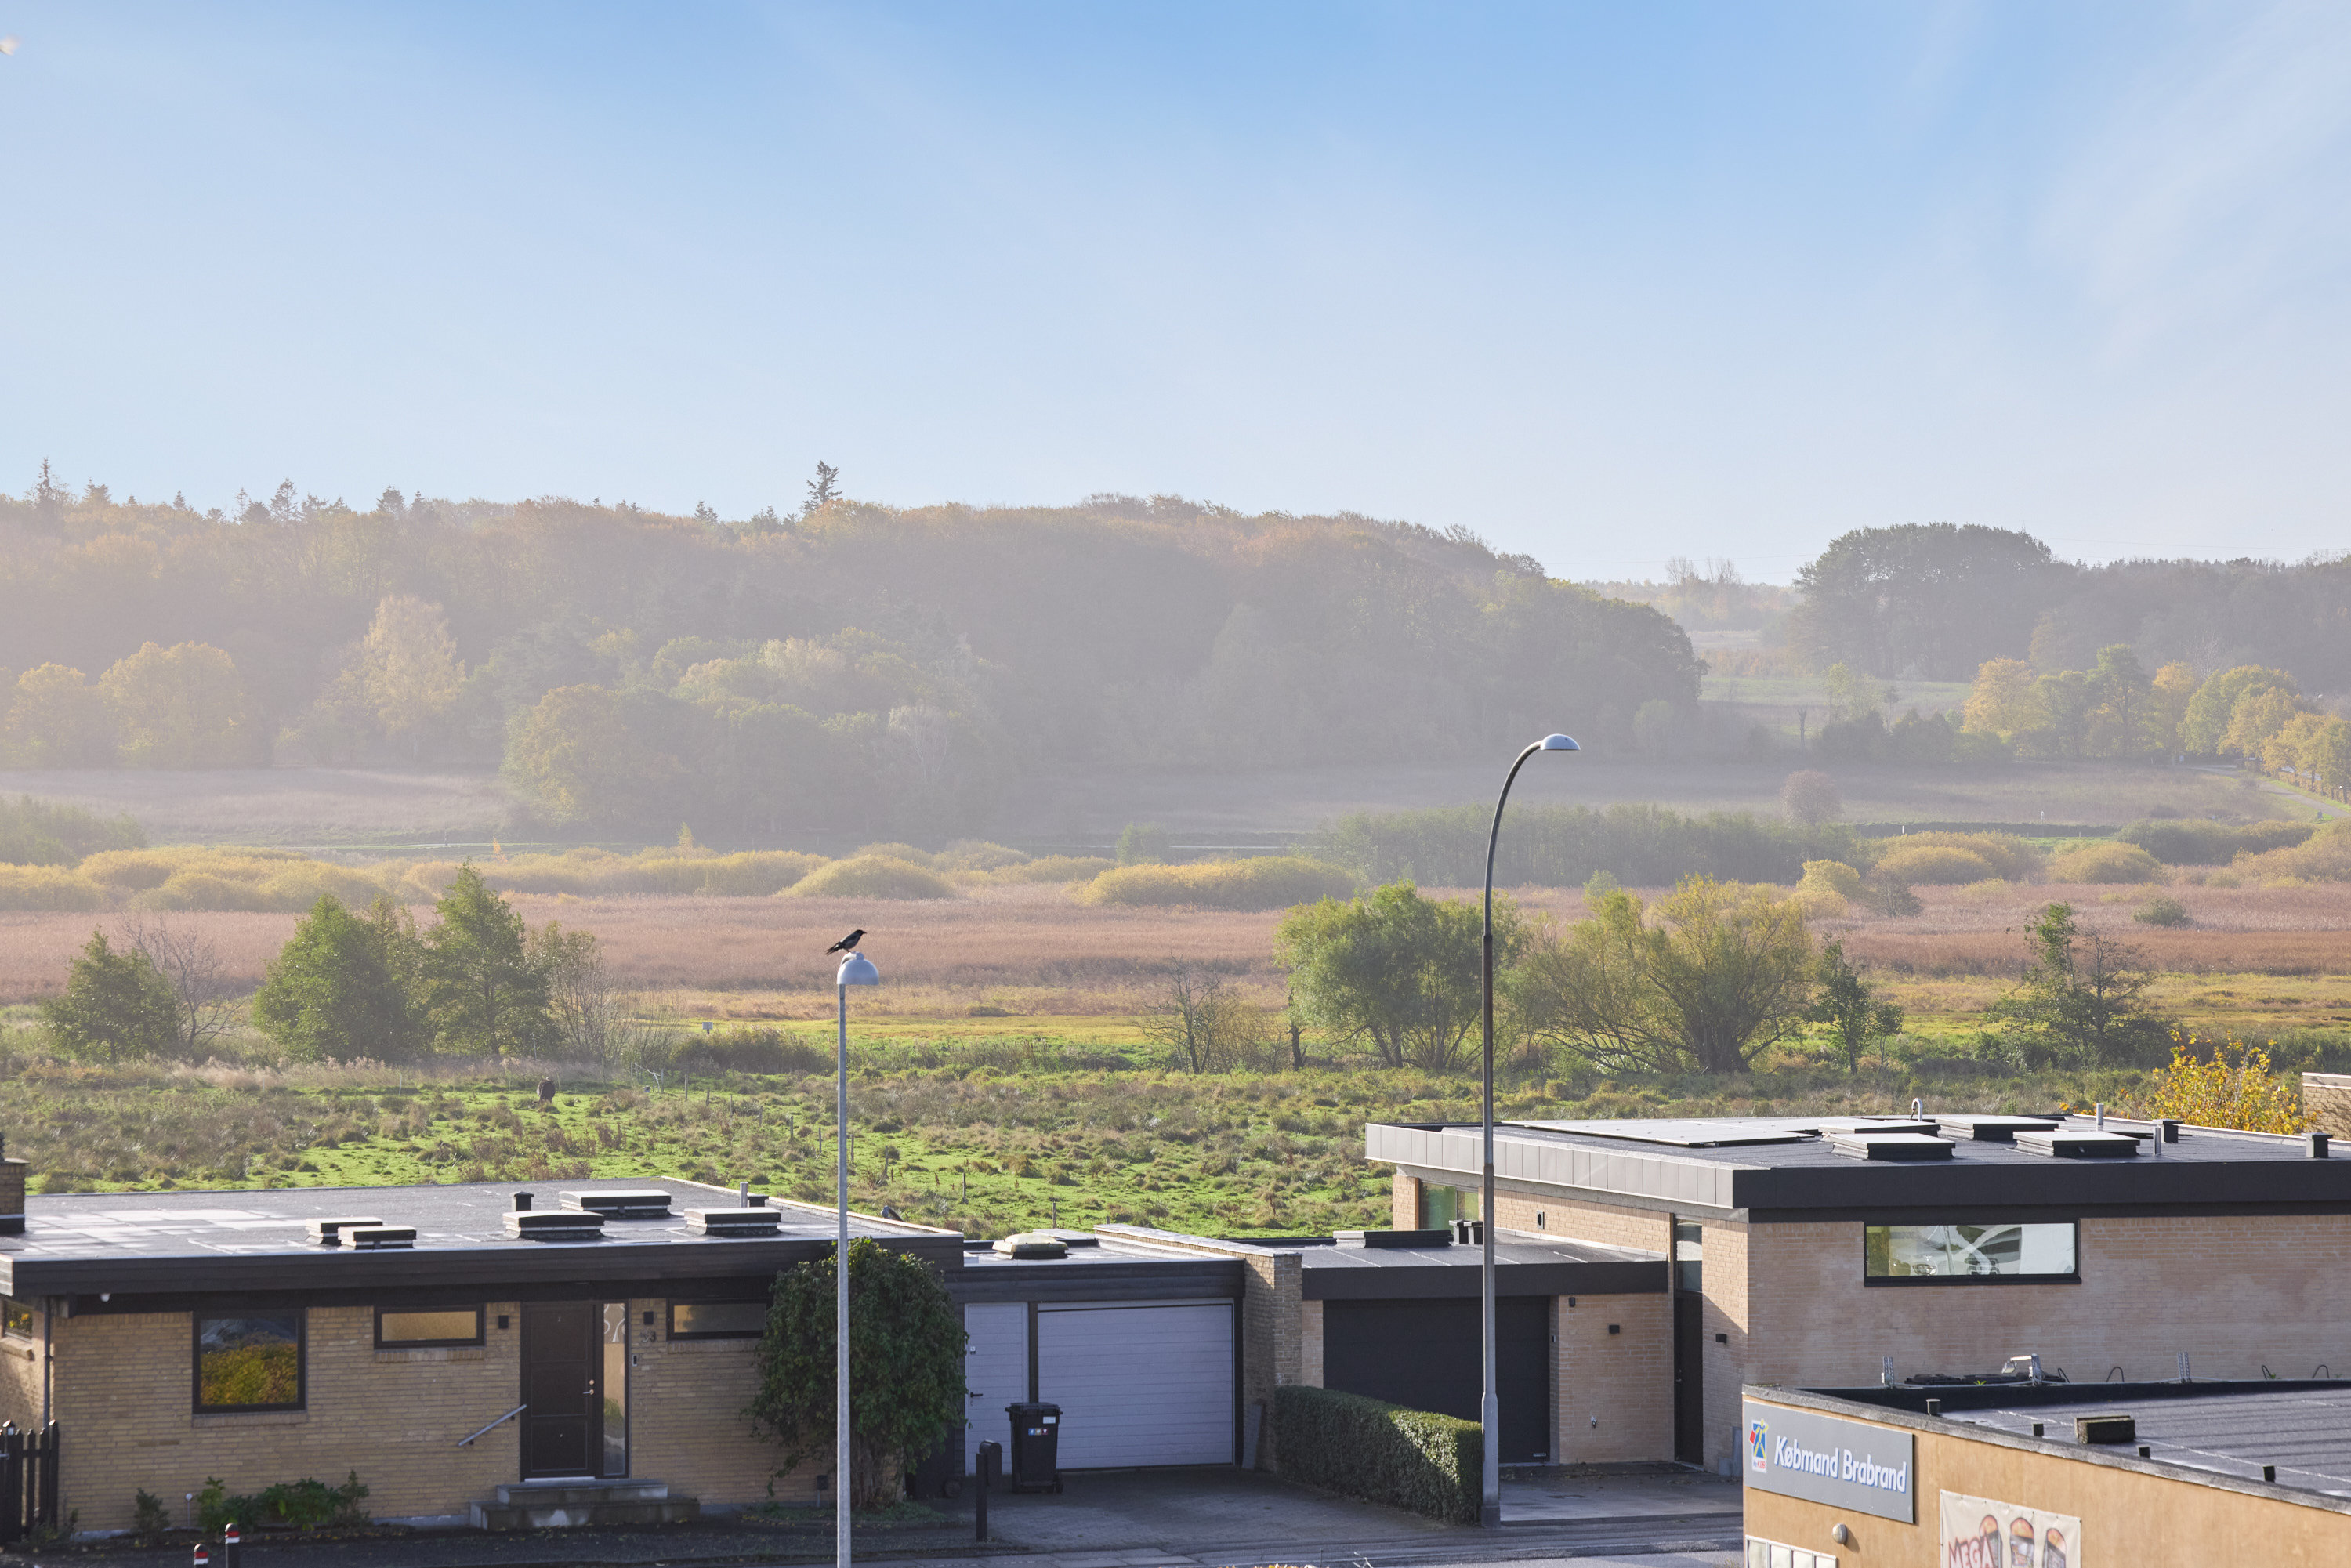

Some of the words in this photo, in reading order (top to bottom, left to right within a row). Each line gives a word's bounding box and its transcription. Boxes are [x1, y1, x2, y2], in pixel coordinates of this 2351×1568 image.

[1774, 1435, 1839, 1479] Købmand
[1842, 1449, 1907, 1494] Brabrand
[1948, 1529, 1995, 1568] MEGA
